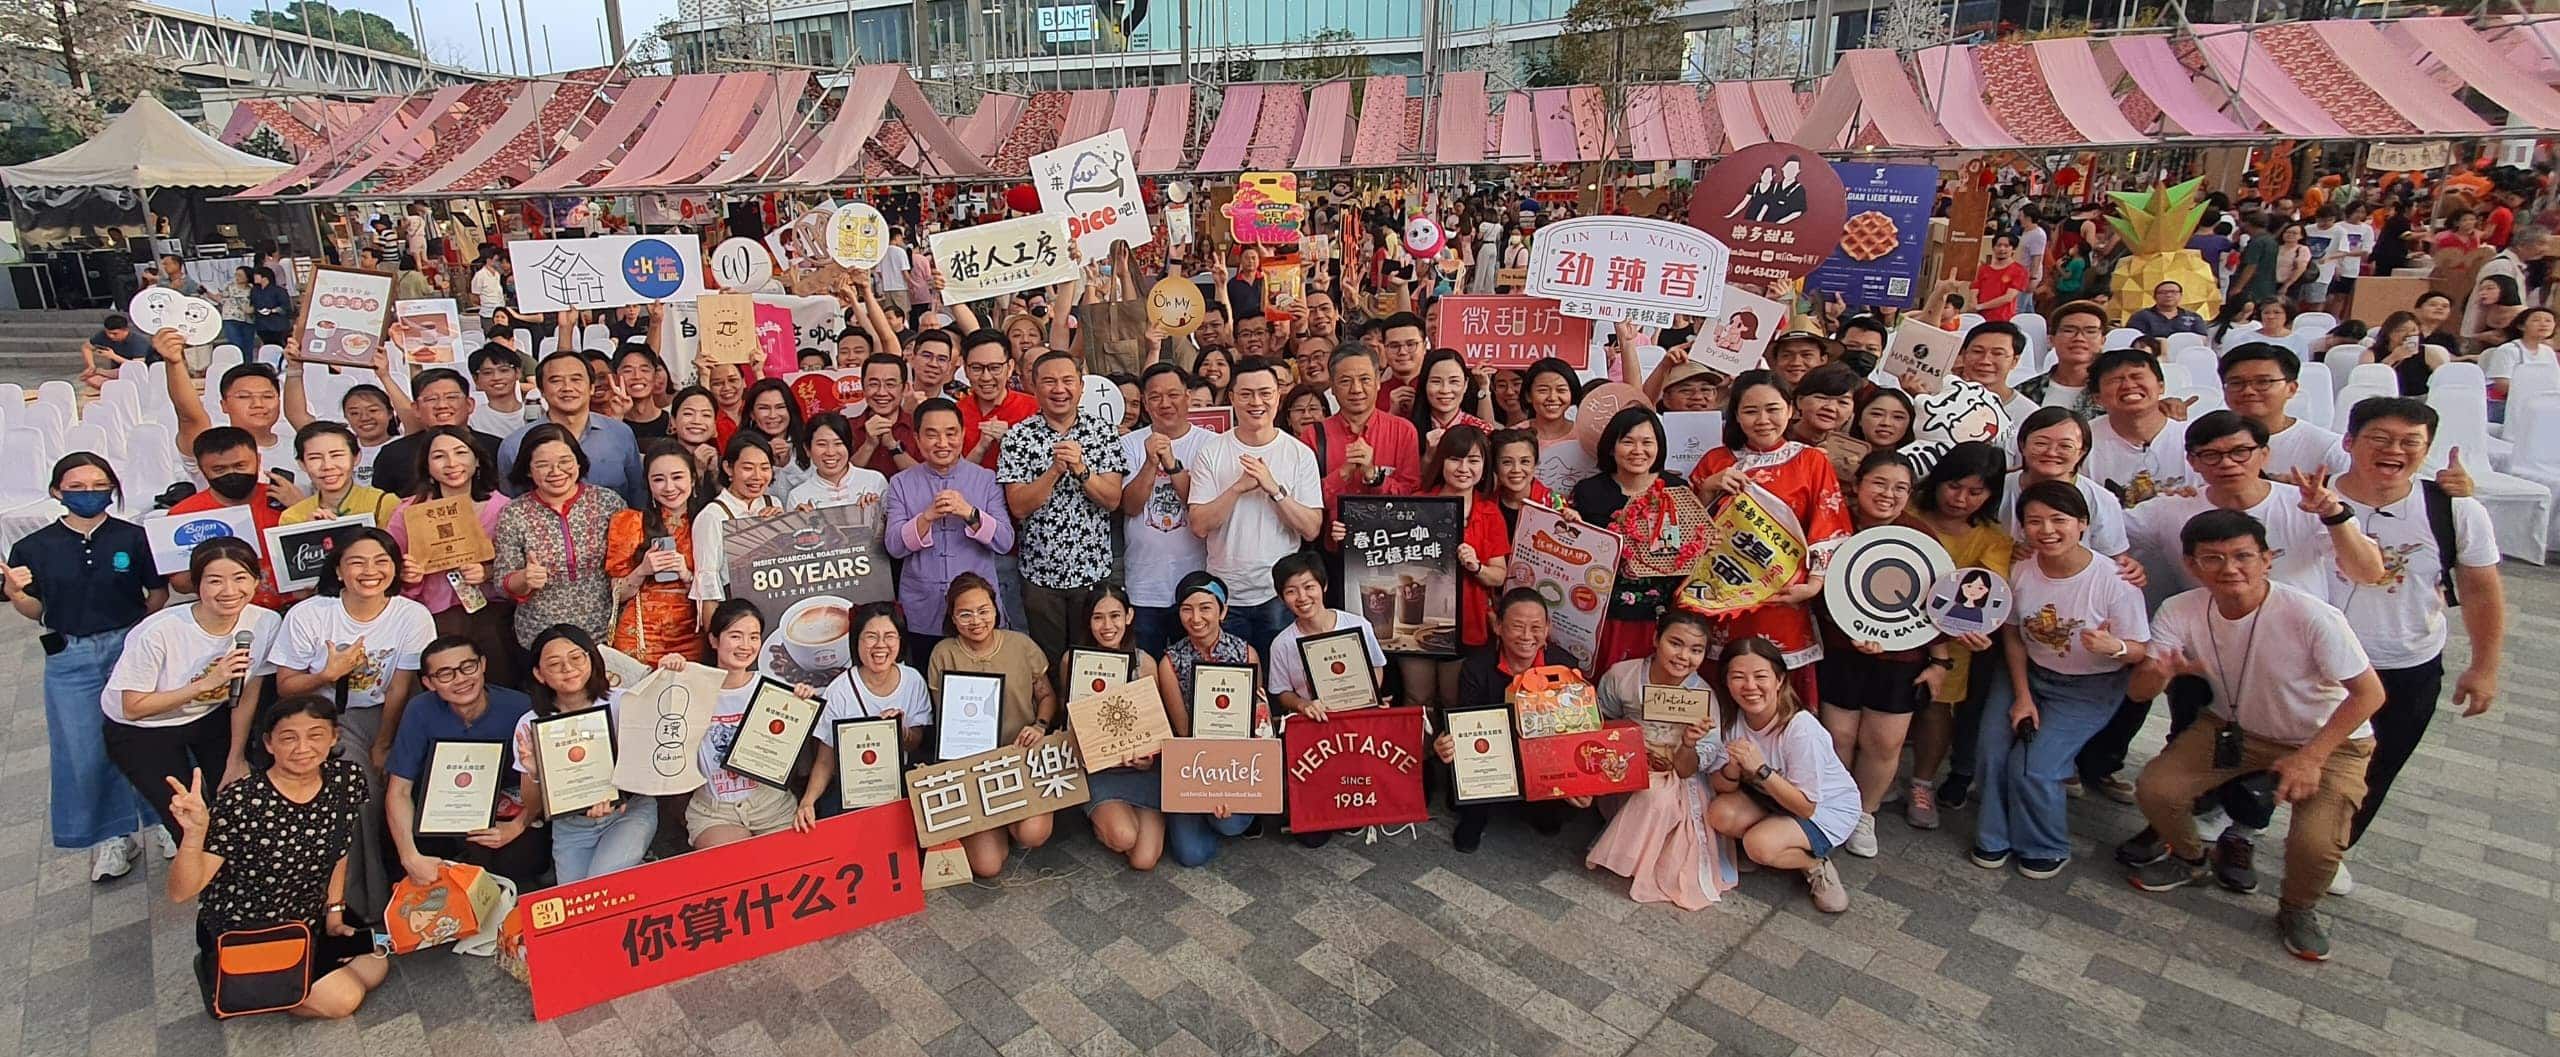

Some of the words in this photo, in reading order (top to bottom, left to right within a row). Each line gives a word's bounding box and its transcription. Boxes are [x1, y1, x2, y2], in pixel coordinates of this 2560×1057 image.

[1889, 196, 1919, 204] WAFFLE
[950, 230, 1058, 282] 猫人工房
[1562, 231, 1590, 244] JIN
[1610, 231, 1630, 241] LA
[1647, 234, 1701, 258] XIANG
[1554, 250, 1700, 298] 劲辣香
[1461, 306, 1563, 346] 微甜坊
[1565, 301, 1593, 316] 全马
[1625, 308, 1673, 326] 辣椒酱
[1466, 343, 1501, 359] WEI
[1508, 343, 1557, 360] TIAN
[1915, 361, 1941, 378] TEAS
[1353, 524, 1431, 549] 春日一咖
[752, 557, 777, 567] INSIST
[777, 552, 816, 564] CHARCOAL
[816, 548, 851, 558] ROASTING
[852, 545, 866, 554] FOR
[1365, 541, 1443, 567] 記憶起啡
[752, 568, 784, 592] 80
[788, 555, 871, 586] YEARS
[1852, 619, 1890, 639] QING
[1100, 731, 1151, 753] CAELUS
[1180, 750, 1265, 787] chantek
[1290, 732, 1418, 783] HERITASTE
[914, 740, 1083, 833] 芭芭樂
[1340, 776, 1372, 785] SINCE
[1333, 791, 1377, 808] 1984
[565, 888, 609, 907] HAPPY
[566, 903, 595, 917] NEW
[602, 893, 636, 908] YEAR
